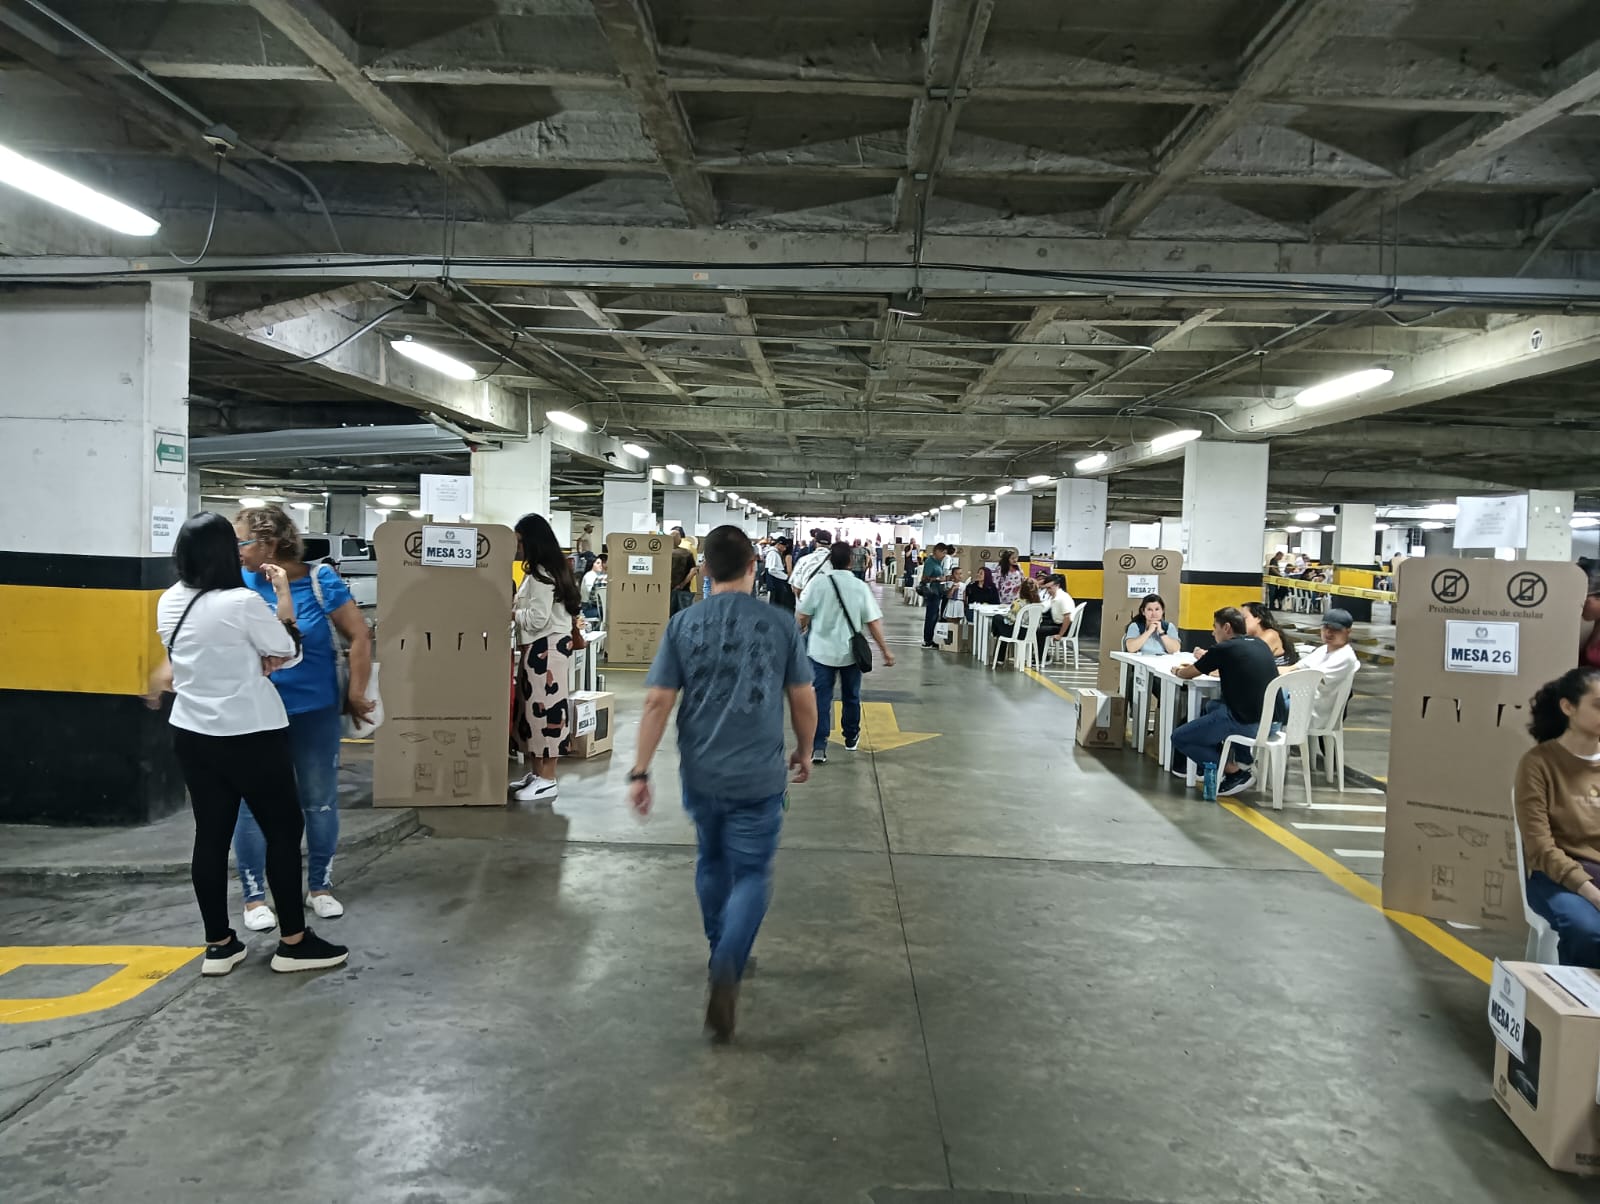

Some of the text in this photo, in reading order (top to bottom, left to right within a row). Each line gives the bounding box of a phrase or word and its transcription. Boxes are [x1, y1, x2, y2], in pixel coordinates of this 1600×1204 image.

[426, 546, 472, 559] MESA 33
[1130, 586, 1147, 594] MESA
[1428, 604, 1545, 620] Prohibido el uso de celular
[1451, 647, 1512, 664] MESA 26
[1490, 999, 1510, 1032] MESA
[1509, 1018, 1521, 1042] 26
